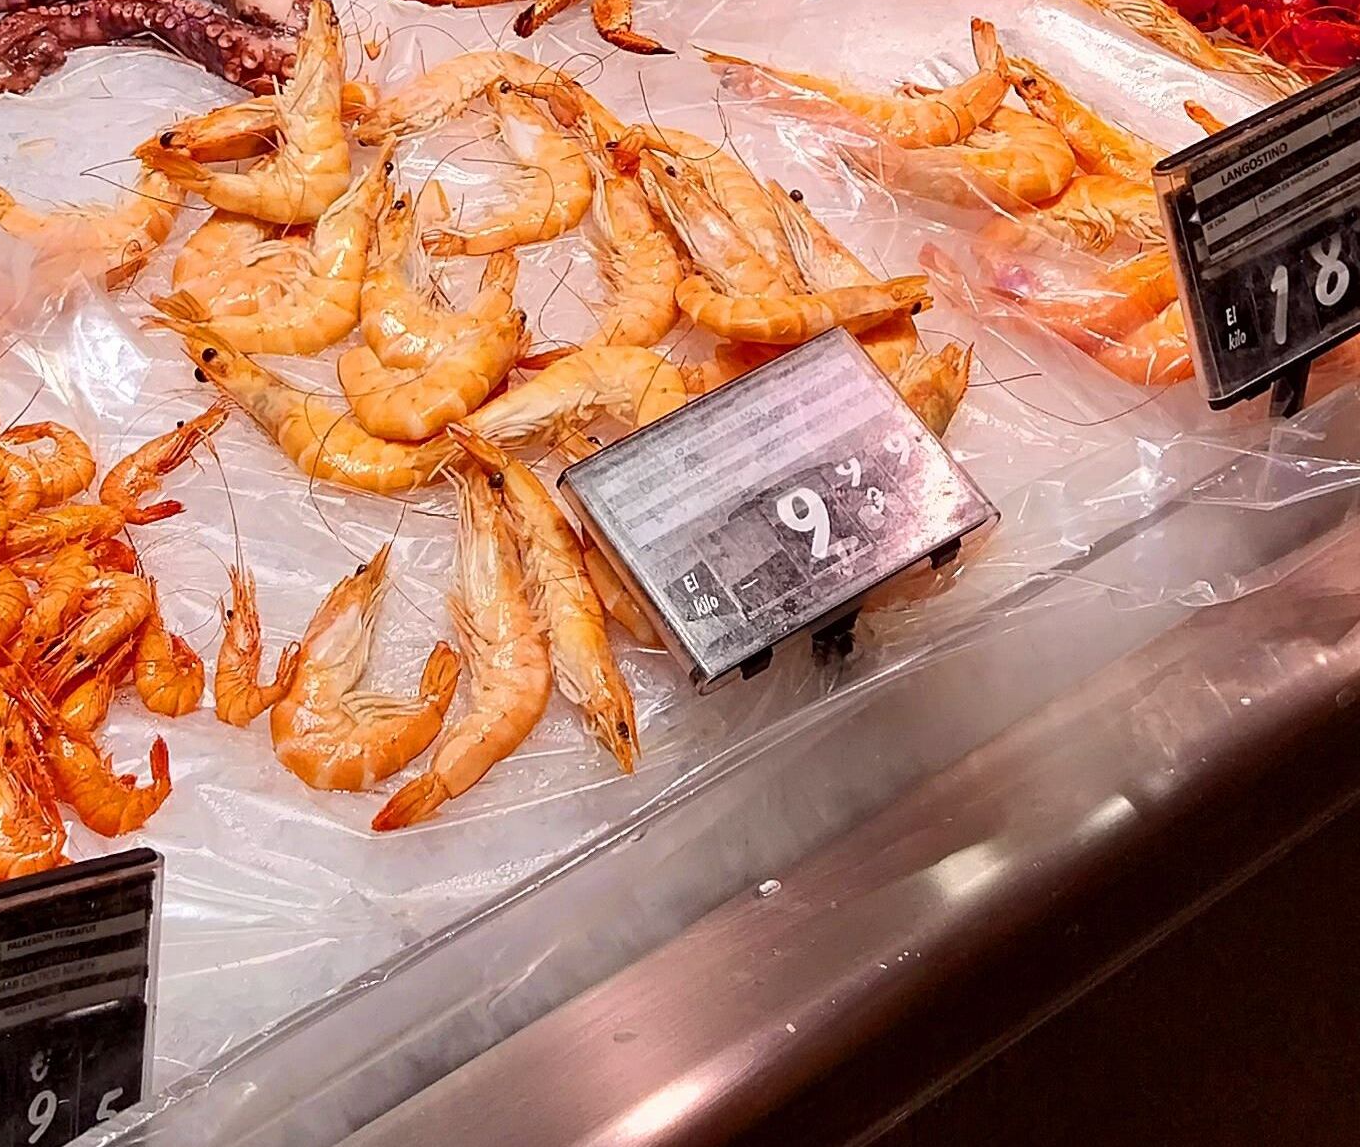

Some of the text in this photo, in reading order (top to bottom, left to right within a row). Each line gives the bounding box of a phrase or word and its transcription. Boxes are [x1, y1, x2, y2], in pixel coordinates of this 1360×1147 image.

[1220, 142, 1288, 186] LANGOSTINO
[1226, 305, 1237, 327] El
[1228, 330, 1247, 351] kilo
[777, 488, 832, 559] 9
[684, 573, 700, 593] El
[693, 594, 719, 617] kilo
